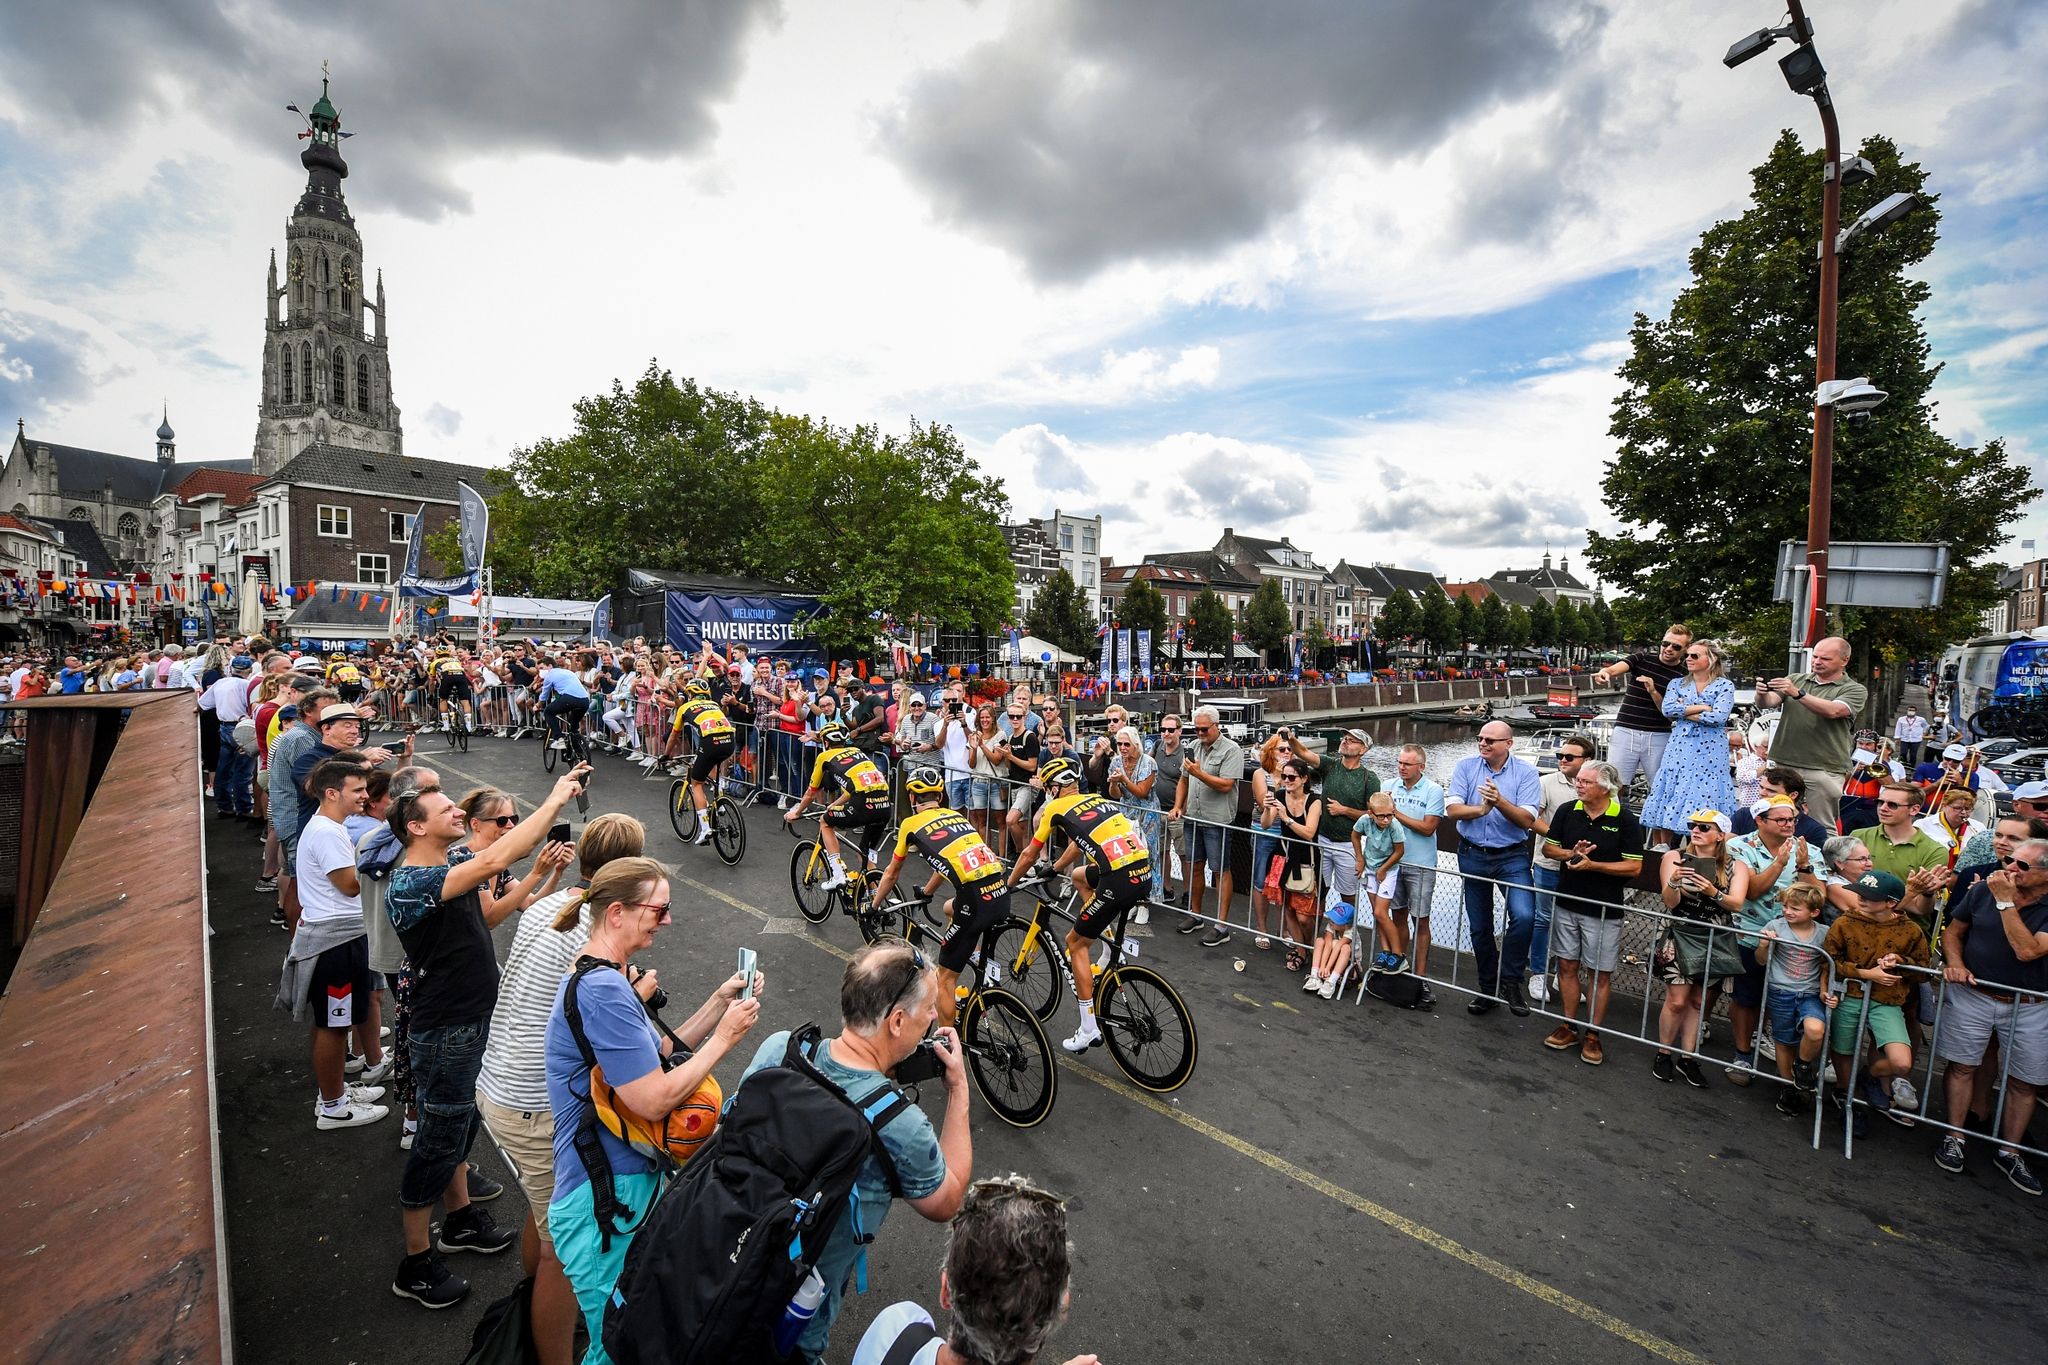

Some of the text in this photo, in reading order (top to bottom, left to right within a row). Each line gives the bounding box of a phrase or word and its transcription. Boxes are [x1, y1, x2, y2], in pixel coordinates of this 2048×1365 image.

[732, 608, 776, 619] WELKOM OP
[322, 639, 345, 651] BAR
[2012, 666, 2030, 675] HELP
[706, 721, 712, 730] 2
[862, 773, 872, 785] 5
[1075, 835, 1097, 858] HEMA
[1112, 840, 1124, 856] 4
[966, 846, 995, 869] 6 6
[927, 855, 950, 877] HEMA
[980, 879, 1005, 895] JUMBO
[991, 885, 1008, 899] VISMA
[1086, 898, 1105, 916] VISMA
[944, 923, 961, 941] VISMA
[1128, 943, 1133, 953] 4
[991, 966, 996, 977] 6
